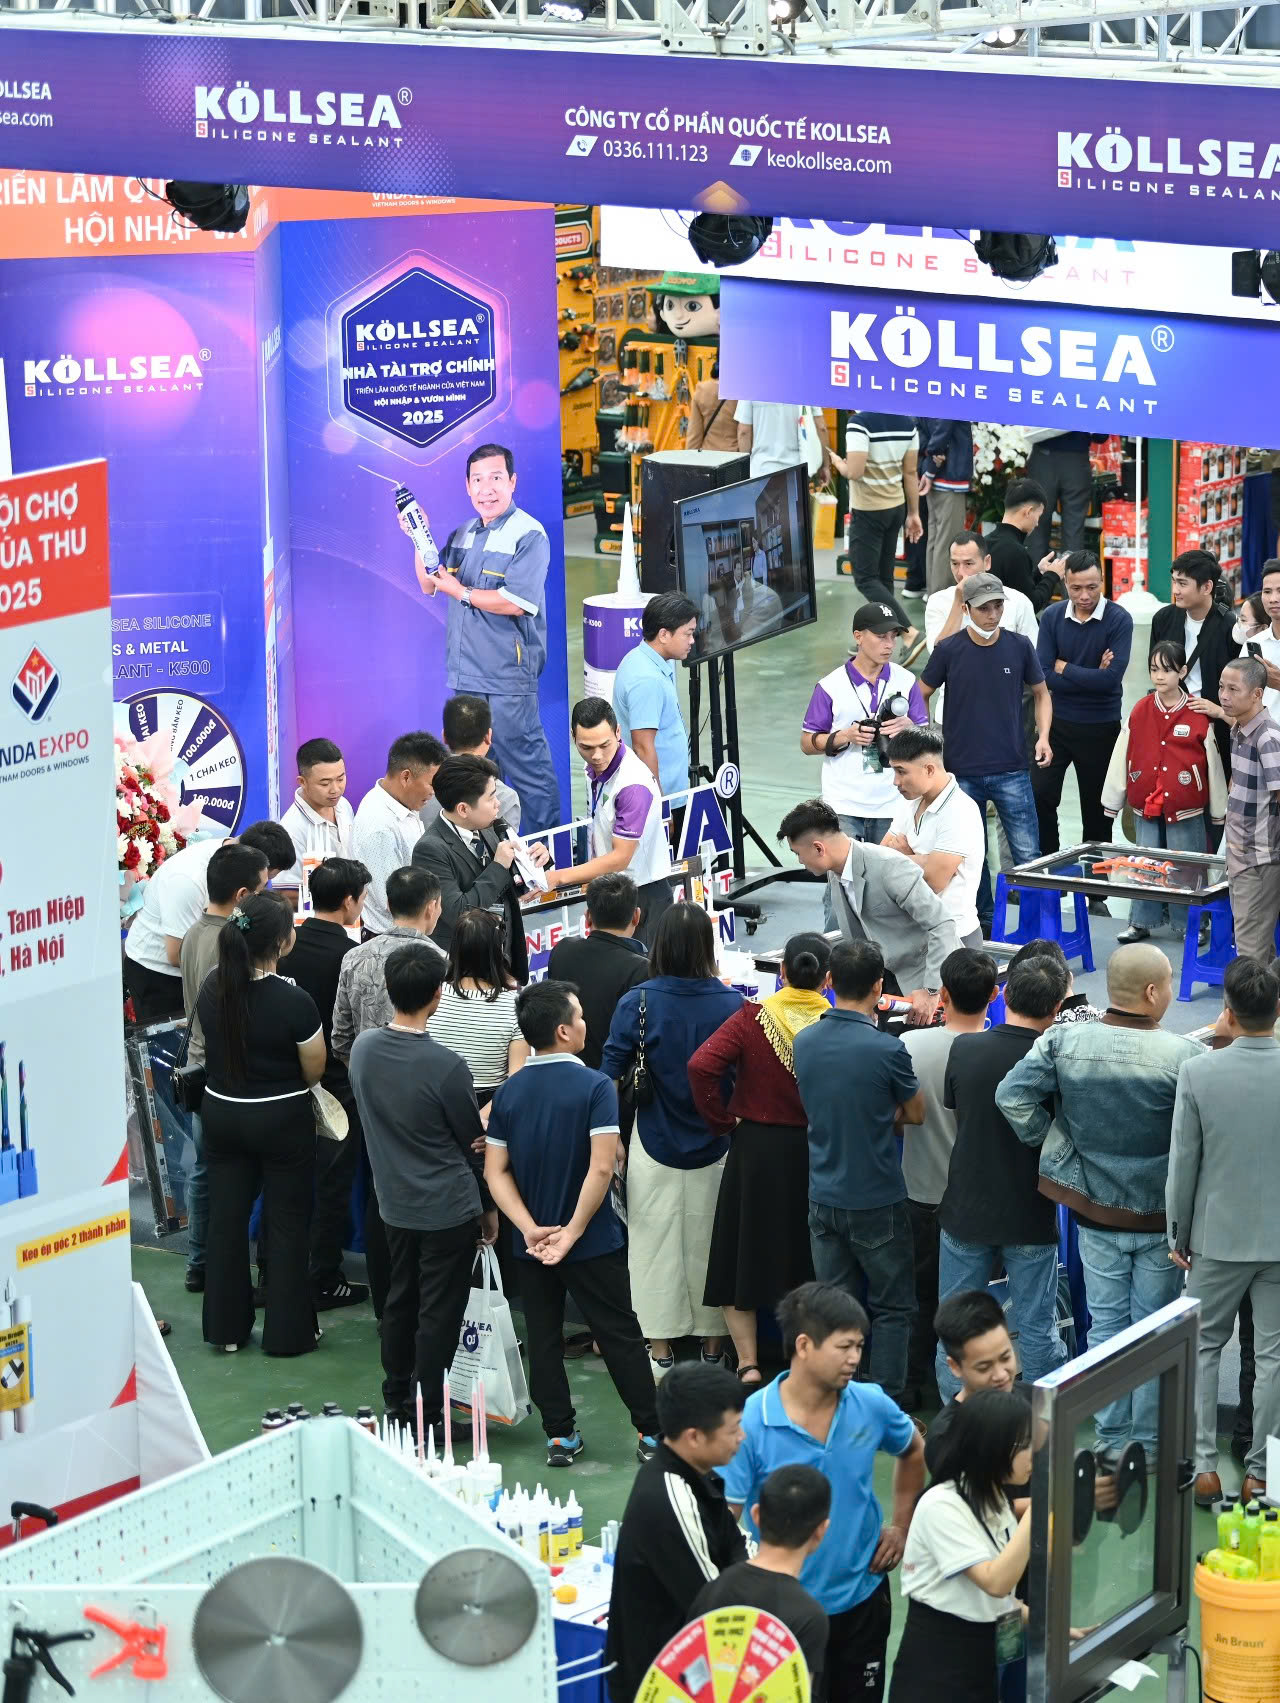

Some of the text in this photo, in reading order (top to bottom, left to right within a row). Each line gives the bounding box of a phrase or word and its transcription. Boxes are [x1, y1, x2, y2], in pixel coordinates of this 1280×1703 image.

[195, 81, 402, 128] KÖLLSEA
[196, 121, 402, 148] SILICONE SEALANT
[565, 106, 891, 145] CÔNG TY CỔ PHẦN QUỐC TẾ KOLLSEA
[603, 139, 708, 162] 0336.111.123
[767, 148, 892, 174] keokollsea.com
[1058, 169, 1174, 194] SILICONE
[65, 211, 114, 246] HỘI
[356, 318, 479, 342] KÖLLSEA
[357, 338, 480, 351] SILICONE SEALANT
[831, 305, 1156, 386] KÖLLSEA
[24, 354, 202, 384] KÖLLSEA
[343, 357, 495, 379] NHÀ TÀI TRỢ CHÍNH
[25, 382, 204, 397] SILICONE SEALANT
[831, 361, 1158, 415] SILICONE SEALANT
[402, 410, 444, 425] 2025
[25, 483, 78, 521] CHỢ
[38, 527, 87, 561] THU
[143, 614, 212, 630] SILICONE
[126, 643, 135, 655] &
[140, 640, 189, 654] METAL
[168, 660, 211, 677] K500
[136, 704, 148, 726] KEO
[176, 699, 184, 715] KEO
[39, 729, 89, 757] EXPO
[182, 719, 217, 763] 100.000đ
[20, 766, 45, 778] DOORS
[54, 756, 89, 771] WINDOWS
[196, 765, 218, 779] CHAI
[220, 755, 237, 767] KEO
[8, 895, 84, 935] Tam Hiệp
[11, 935, 64, 971] Hà Nội
[22, 1247, 38, 1262] Keo
[41, 1241, 51, 1257] ép
[54, 1235, 70, 1254] góc
[72, 1233, 77, 1245] 2
[79, 1224, 103, 1243] thành
[1214, 1633, 1262, 1648] Jin Braun
